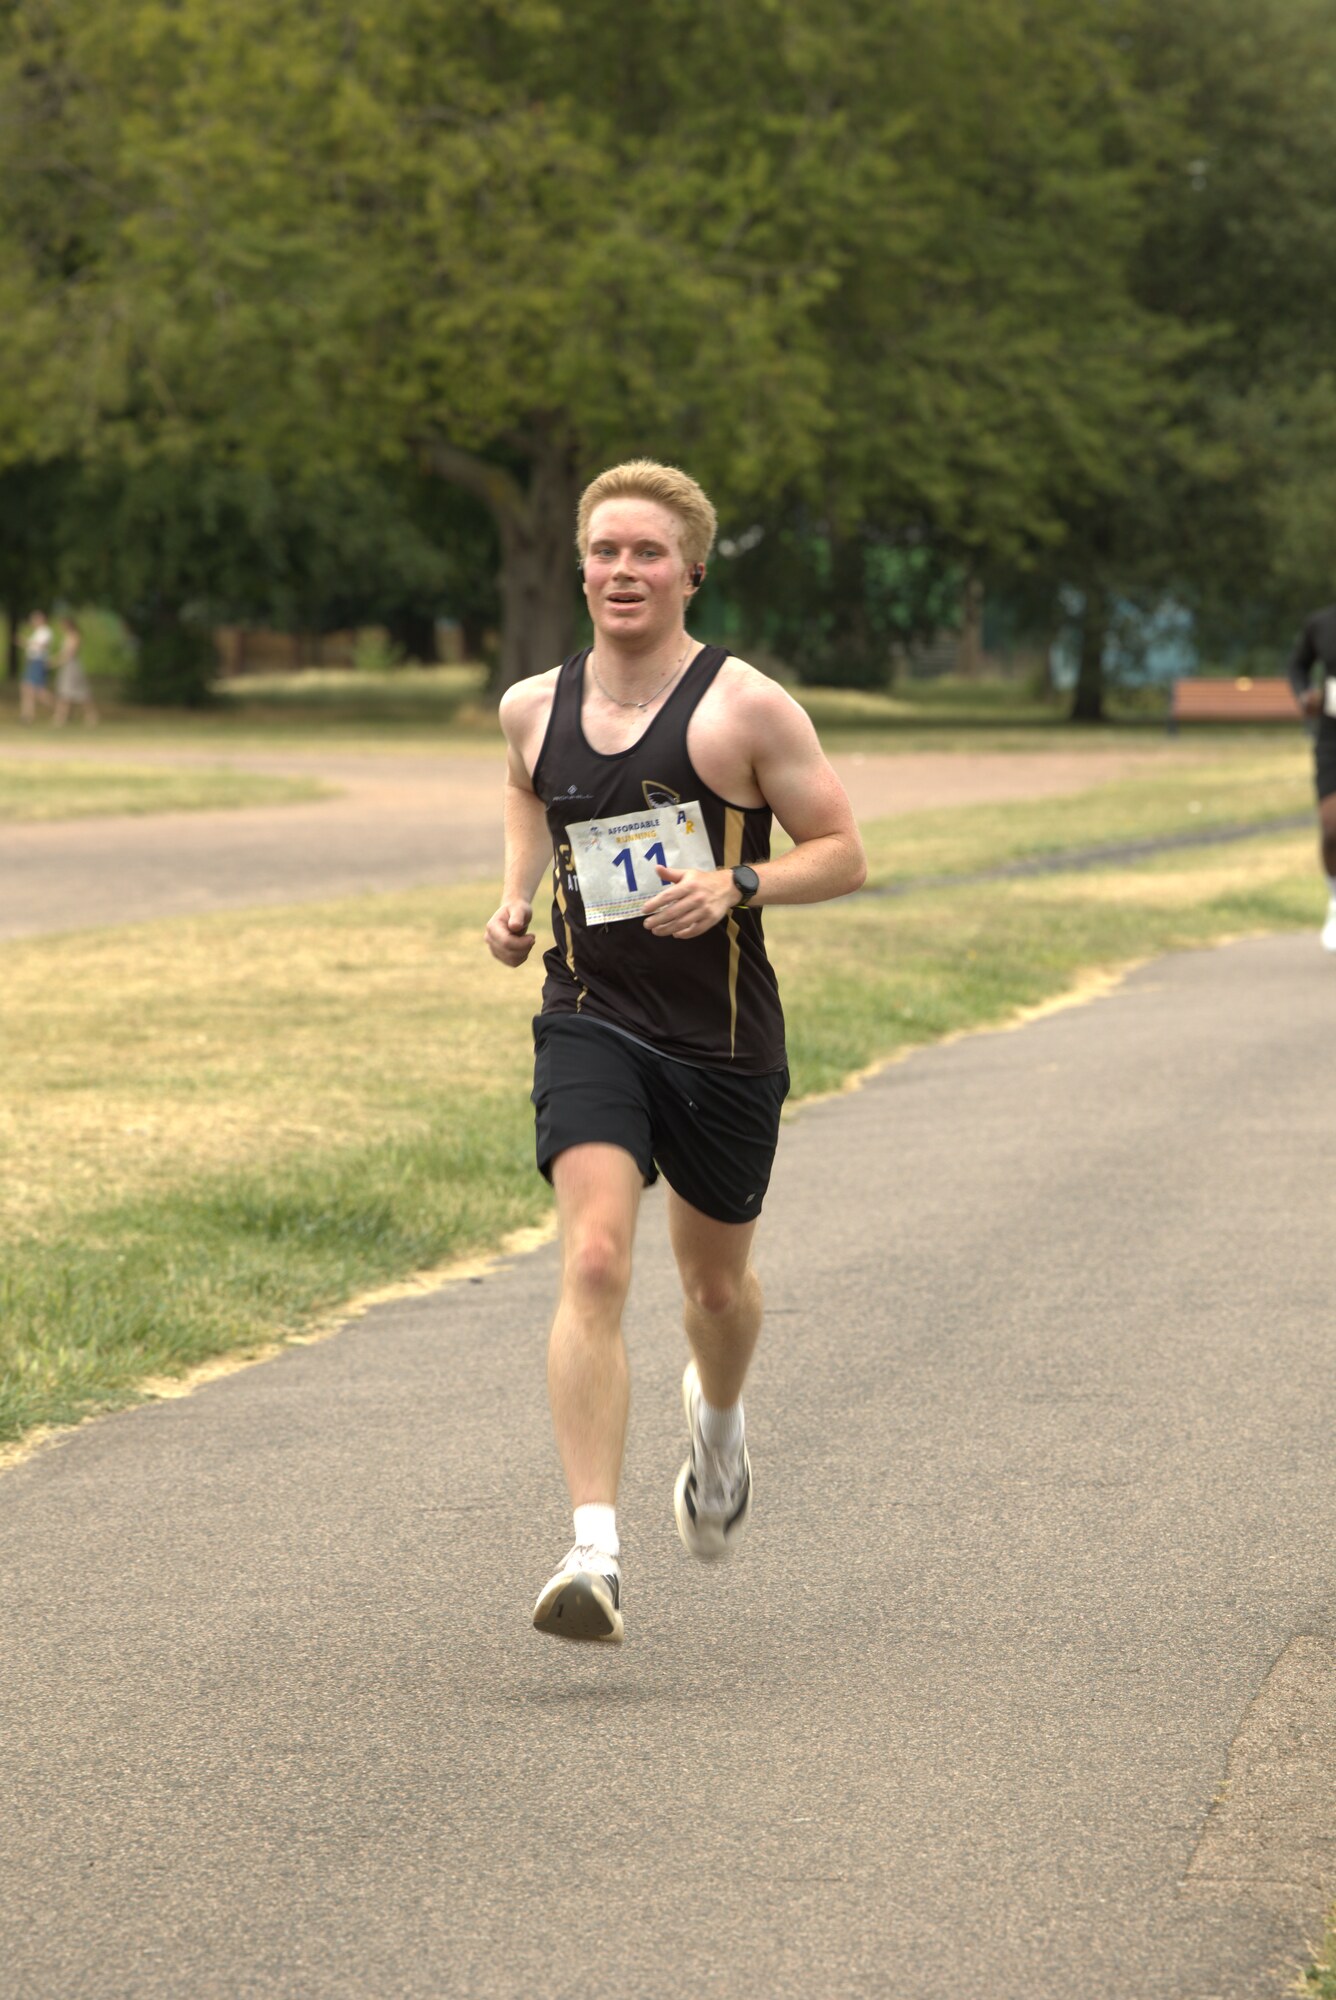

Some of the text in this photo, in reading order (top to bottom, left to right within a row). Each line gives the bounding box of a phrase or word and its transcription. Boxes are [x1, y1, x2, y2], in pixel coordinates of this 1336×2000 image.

[676, 811, 687, 825] A
[608, 819, 660, 835] AFFORDABLE
[616, 831, 657, 844] RUNNING
[612, 842, 671, 893] 11
